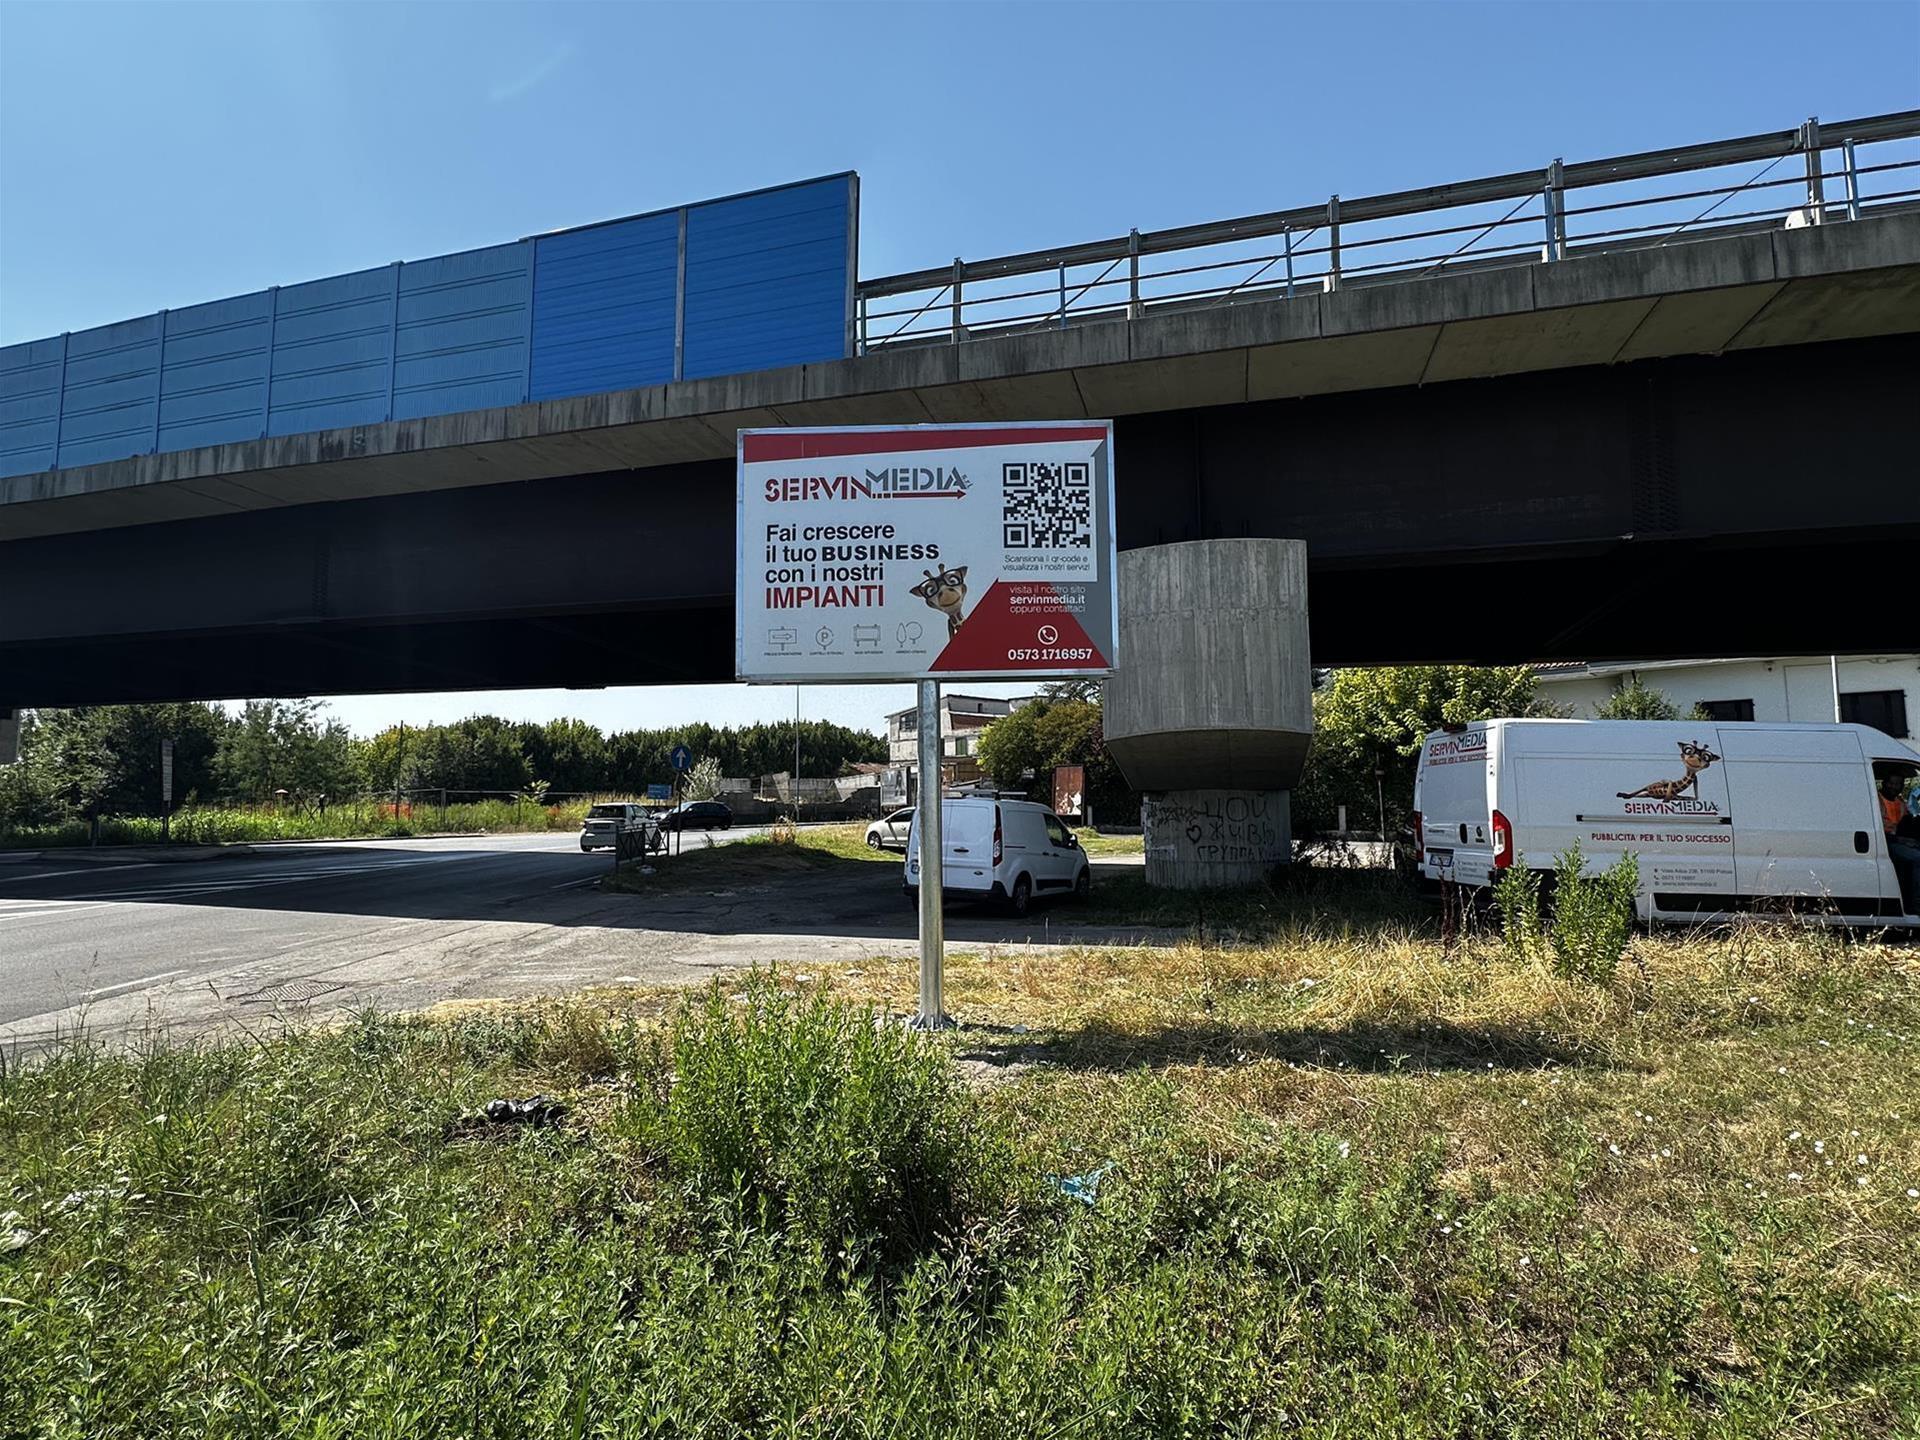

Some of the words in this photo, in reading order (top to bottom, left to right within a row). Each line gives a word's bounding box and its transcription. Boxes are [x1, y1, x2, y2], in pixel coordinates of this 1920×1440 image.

[766, 523, 796, 542] Fai
[803, 524, 895, 541] crescere
[766, 545, 776, 563] il
[783, 546, 817, 562] tuo
[822, 544, 940, 561] BUSINESS
[1004, 554, 1044, 563] Scansiona
[765, 568, 805, 583] con
[811, 564, 816, 582] i
[823, 562, 884, 582] nostri
[1009, 585, 1033, 594] visita
[1041, 585, 1068, 594] nostro
[1070, 584, 1086, 593] sito
[766, 585, 884, 609] IMPIANTI
[1009, 594, 1085, 605] servinmedia.it
[1009, 605, 1041, 614] oppure
[1043, 604, 1086, 613] contattaci
[1008, 649, 1039, 660] 0573
[1041, 648, 1093, 660] 1716957
[1640, 833, 1654, 842] PER
[1656, 833, 1664, 842] IL
[1665, 834, 1683, 843] TUO
[1685, 834, 1731, 844] SUCCESSO
